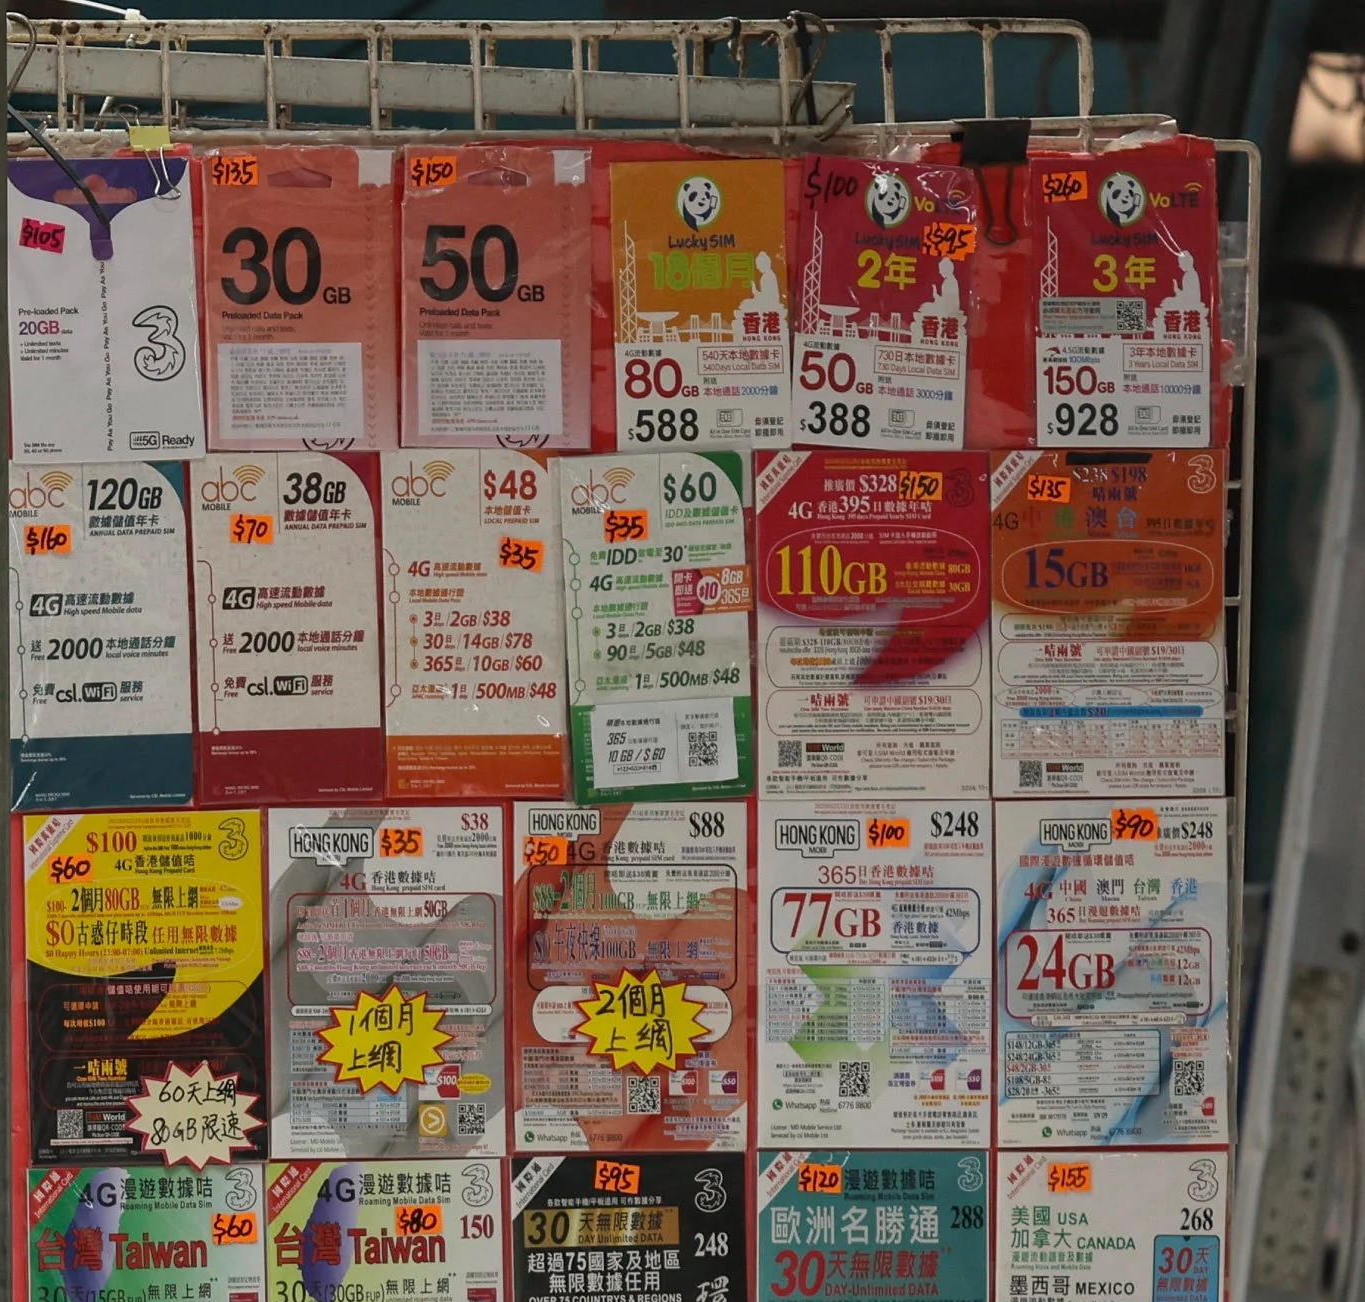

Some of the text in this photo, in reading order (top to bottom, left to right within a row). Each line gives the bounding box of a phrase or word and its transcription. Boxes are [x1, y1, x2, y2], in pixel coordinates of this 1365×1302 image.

[213, 160, 257, 183] $135
[628, 408, 699, 443] $588
[800, 402, 870, 437] $388
[1047, 403, 1119, 438] $928
[162, 434, 195, 449] Ready
[484, 470, 537, 501] $48
[663, 472, 717, 504] $60
[47, 637, 103, 661] 2000
[689, 812, 726, 839] $88
[930, 812, 979, 839] $248
[86, 832, 137, 853] $100
[380, 829, 420, 855] $35
[781, 892, 882, 940] 77GB
[1016, 934, 1116, 992] 24GB
[460, 1214, 495, 1240] 150
[1010, 1206, 1089, 1227] 美國 USA
[1179, 1207, 1215, 1232] 268
[110, 1232, 208, 1270] Taiwan
[348, 1229, 447, 1264] Taiwan
[693, 1232, 729, 1258] 248
[1077, 1236, 1136, 1251] CANADA
[1075, 1280, 1136, 1295] MEXICO
